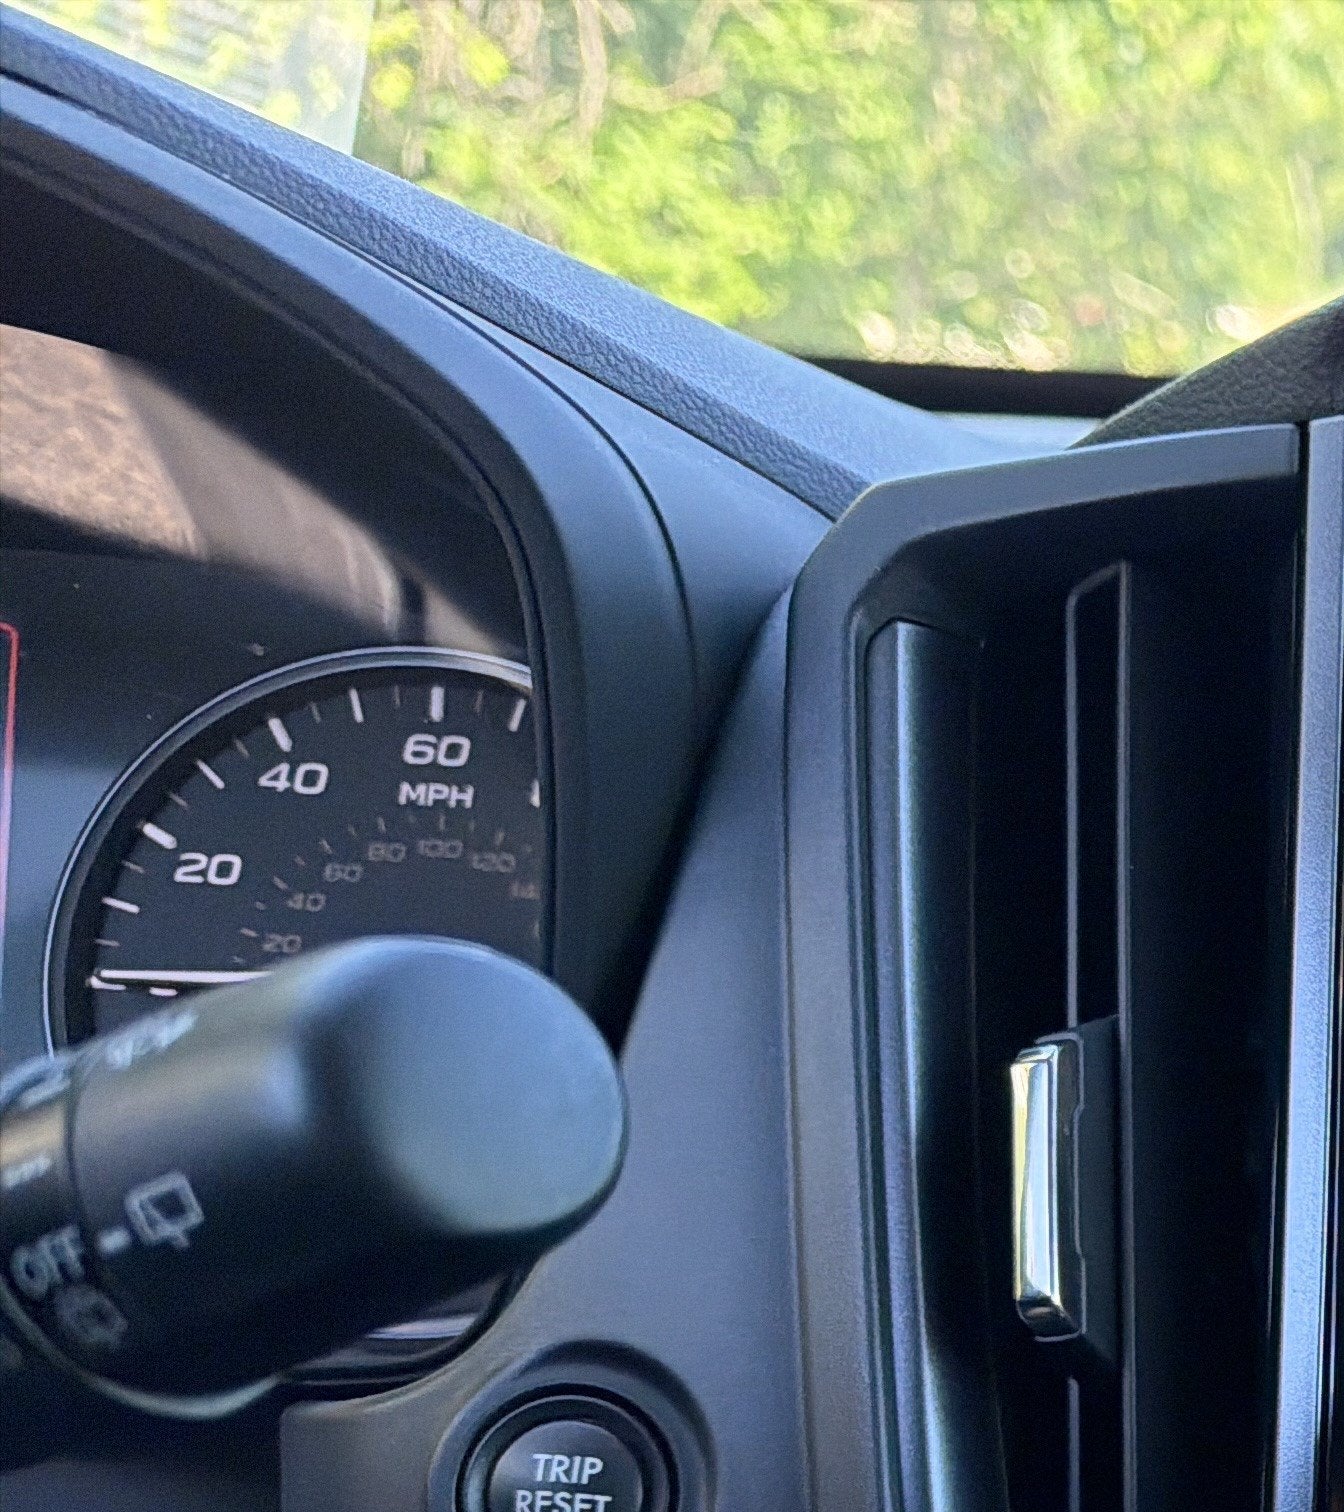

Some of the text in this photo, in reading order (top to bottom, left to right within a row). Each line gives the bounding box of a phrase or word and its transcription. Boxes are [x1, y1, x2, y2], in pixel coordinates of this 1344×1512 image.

[402, 734, 471, 767] 60
[258, 762, 329, 795] 40
[398, 783, 474, 808] MPH
[174, 852, 242, 886] 20
[532, 1453, 604, 1486] TRIP
